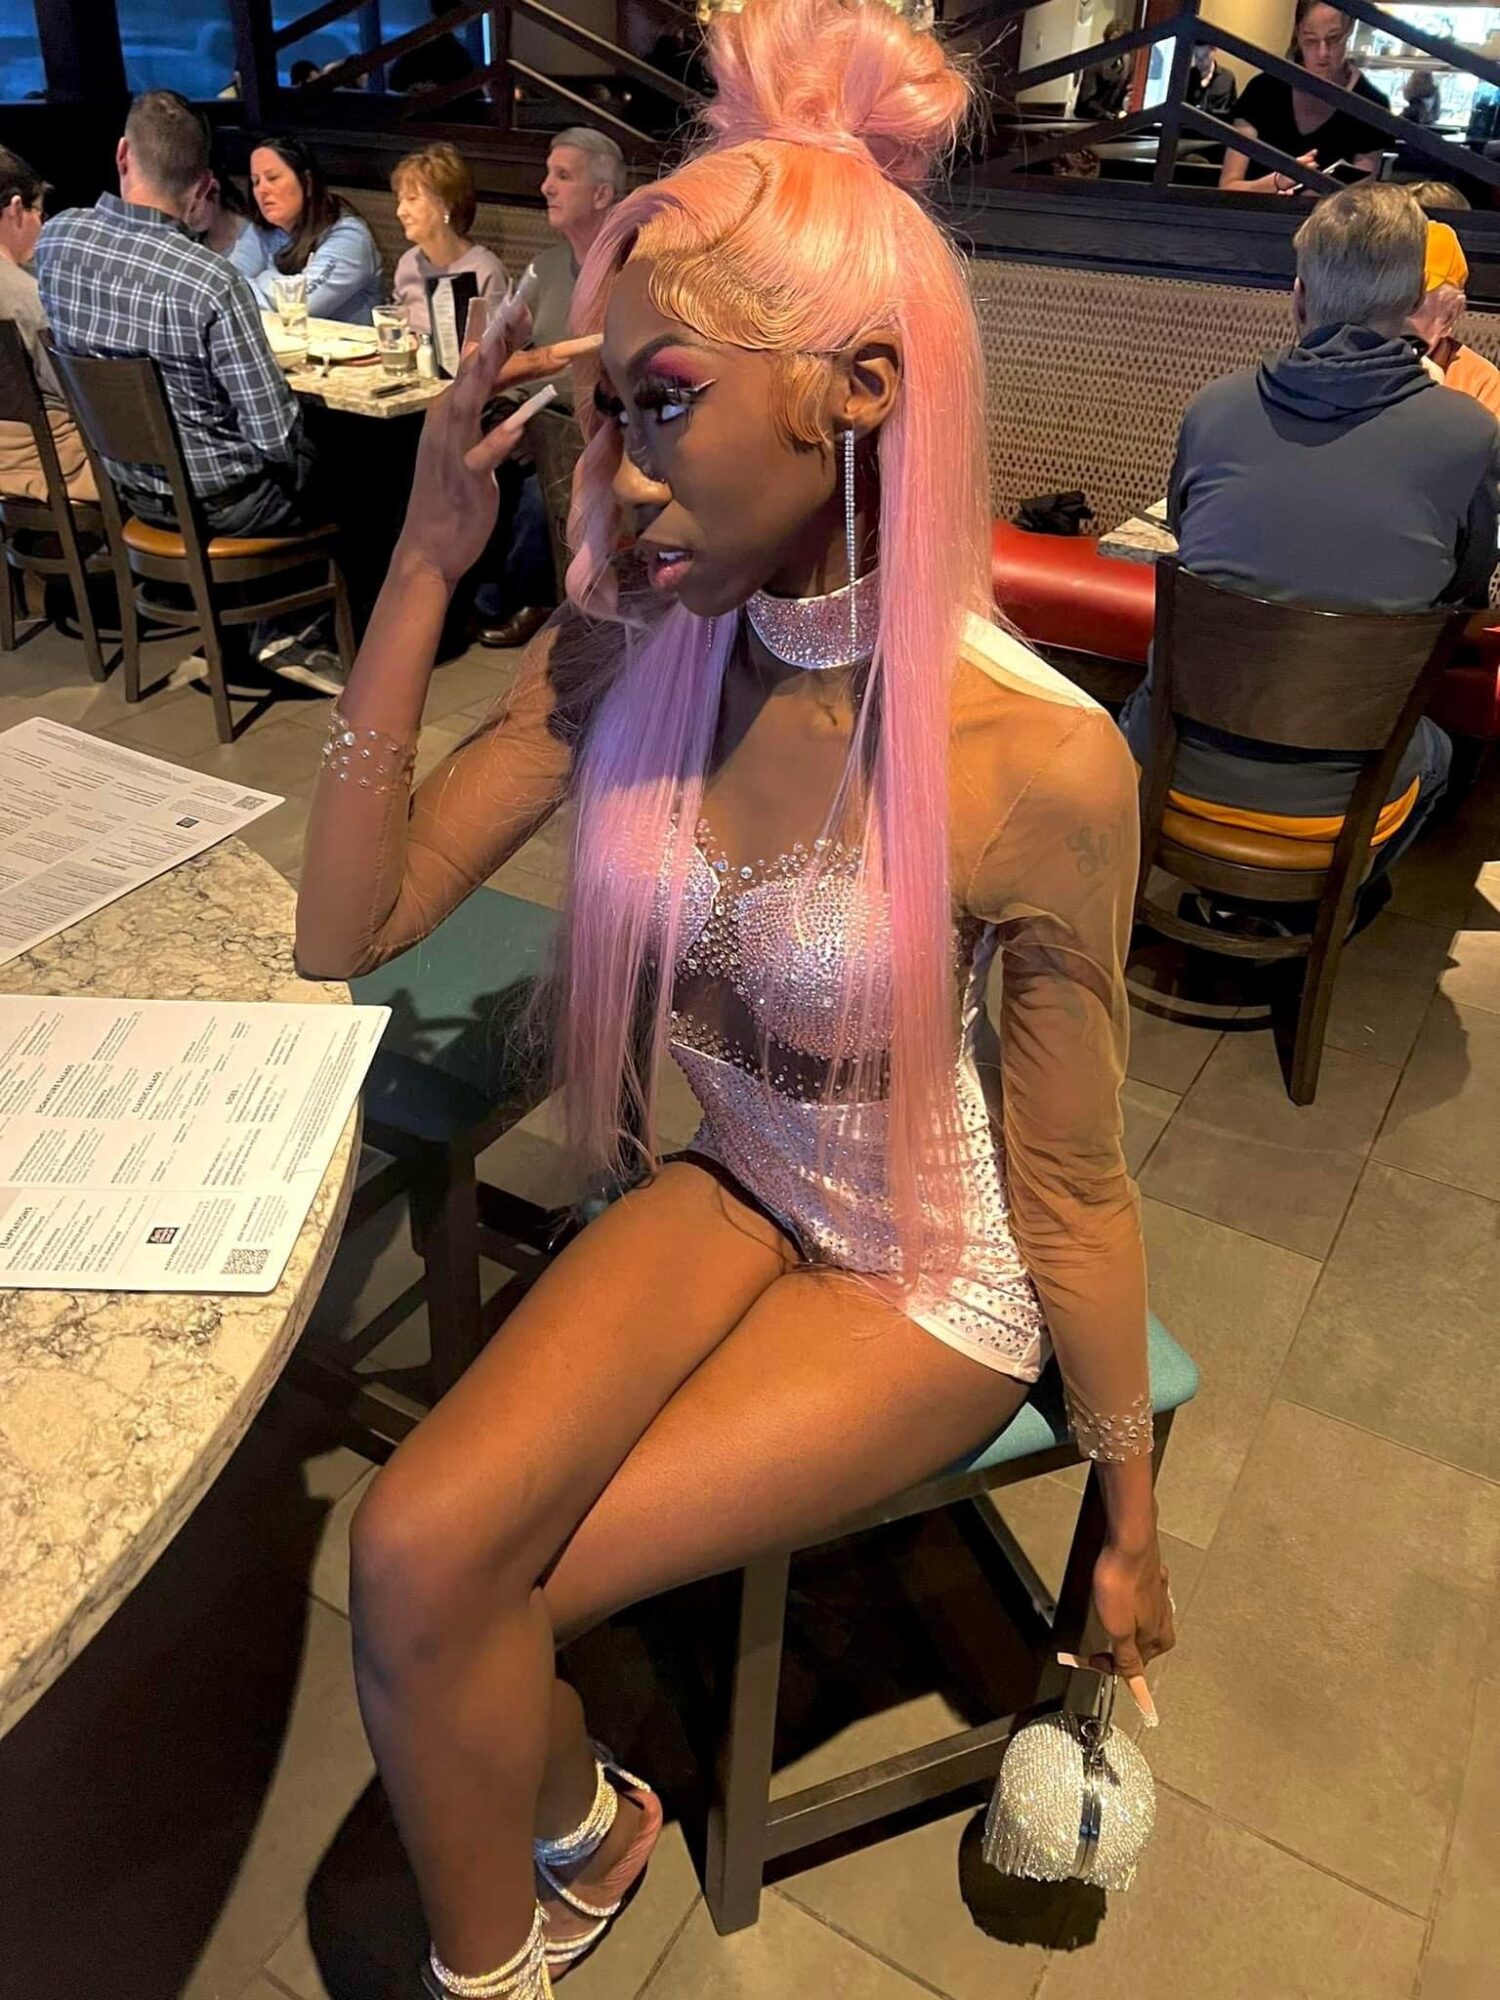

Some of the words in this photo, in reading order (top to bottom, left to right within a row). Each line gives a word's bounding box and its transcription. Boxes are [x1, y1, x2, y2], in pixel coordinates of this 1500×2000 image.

[35, 1083, 62, 1113] SIGNATURE
[55, 1064, 75, 1083] SALADS
[131, 1090, 152, 1113] CLASSIC
[144, 1071, 163, 1090] SALADS
